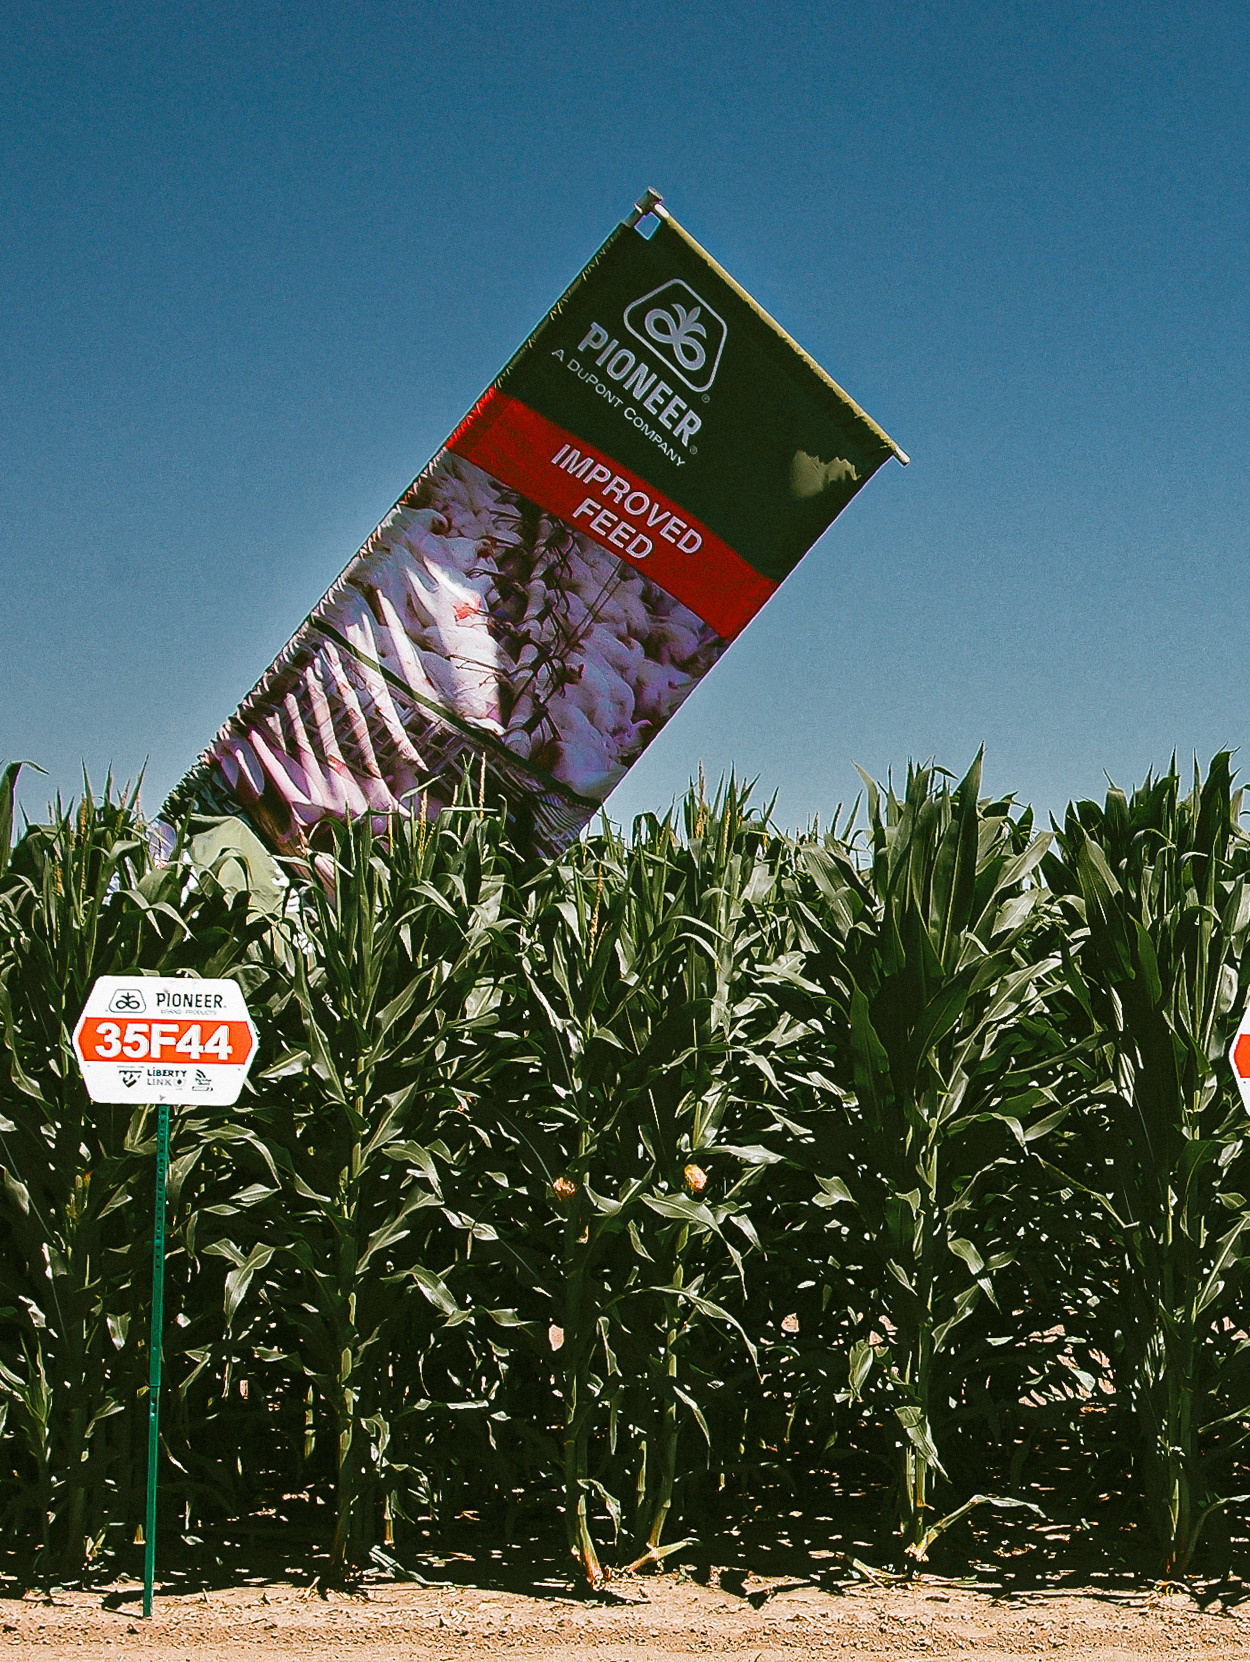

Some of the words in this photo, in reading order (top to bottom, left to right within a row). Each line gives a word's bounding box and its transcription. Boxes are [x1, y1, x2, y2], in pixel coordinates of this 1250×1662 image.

[551, 349, 565, 362] A
[624, 407, 686, 467] COMPANY
[578, 322, 702, 447] PIONEER
[551, 444, 703, 554] IMPROVED
[572, 497, 653, 559] FEED
[94, 1022, 233, 1061] 35F44
[156, 992, 224, 1008] PIONEER
